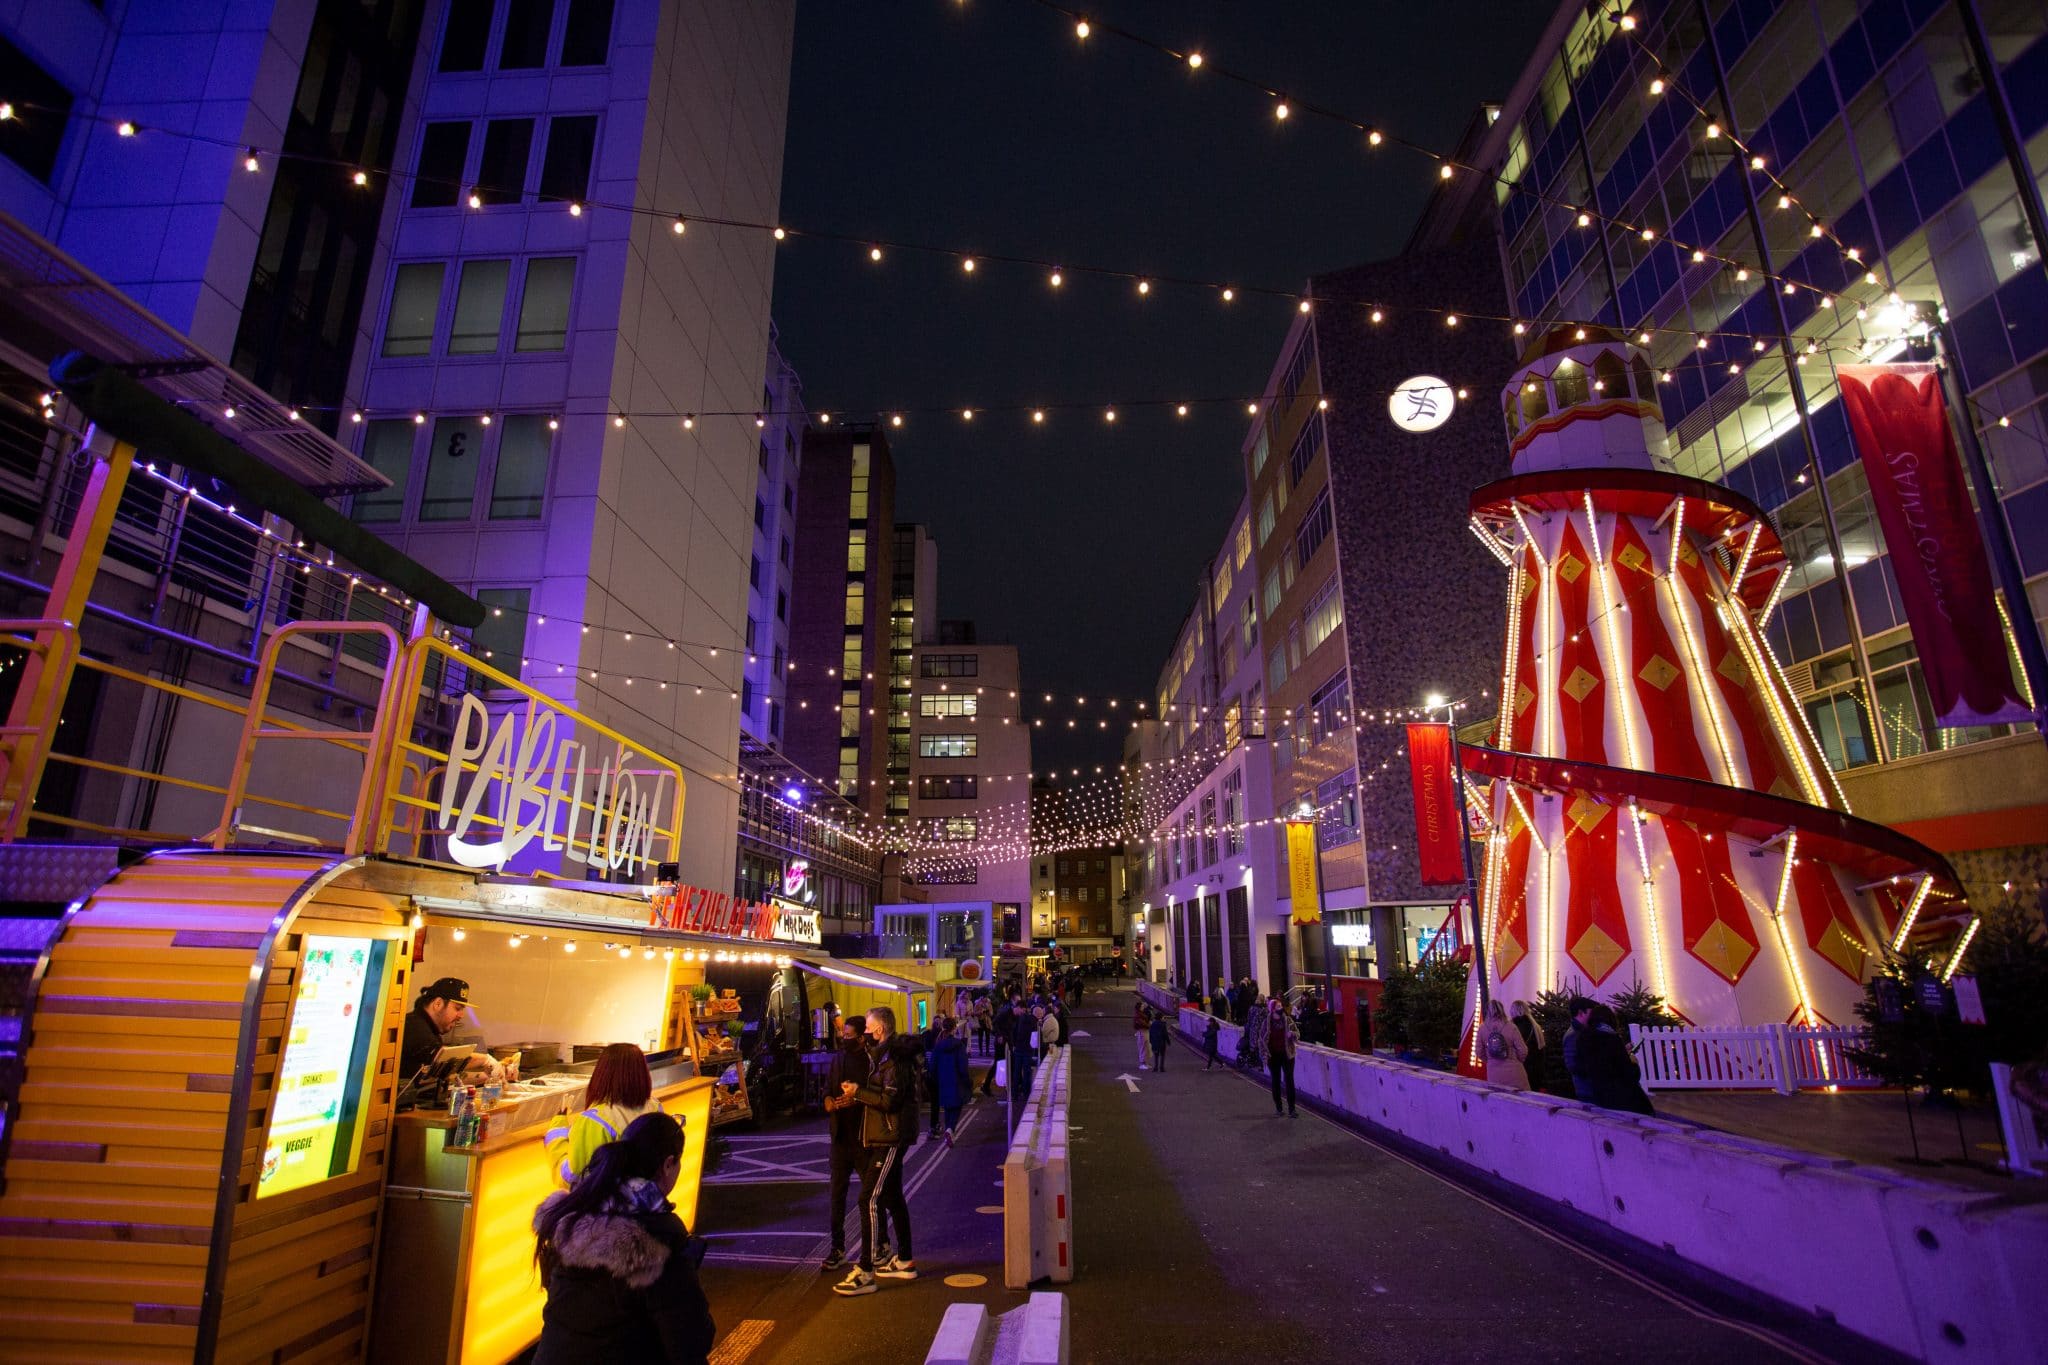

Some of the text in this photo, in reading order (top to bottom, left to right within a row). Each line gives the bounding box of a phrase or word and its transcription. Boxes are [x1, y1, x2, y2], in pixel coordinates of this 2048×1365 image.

[438, 692, 666, 878] PABELLÓN
[1421, 763, 1440, 843] CHRISTMAS
[1295, 848, 1305, 898] CHRISTMAS
[1303, 855, 1313, 892] MARKET
[302, 1073, 323, 1086] DRINKS
[285, 1136, 313, 1153] VEGGIE
